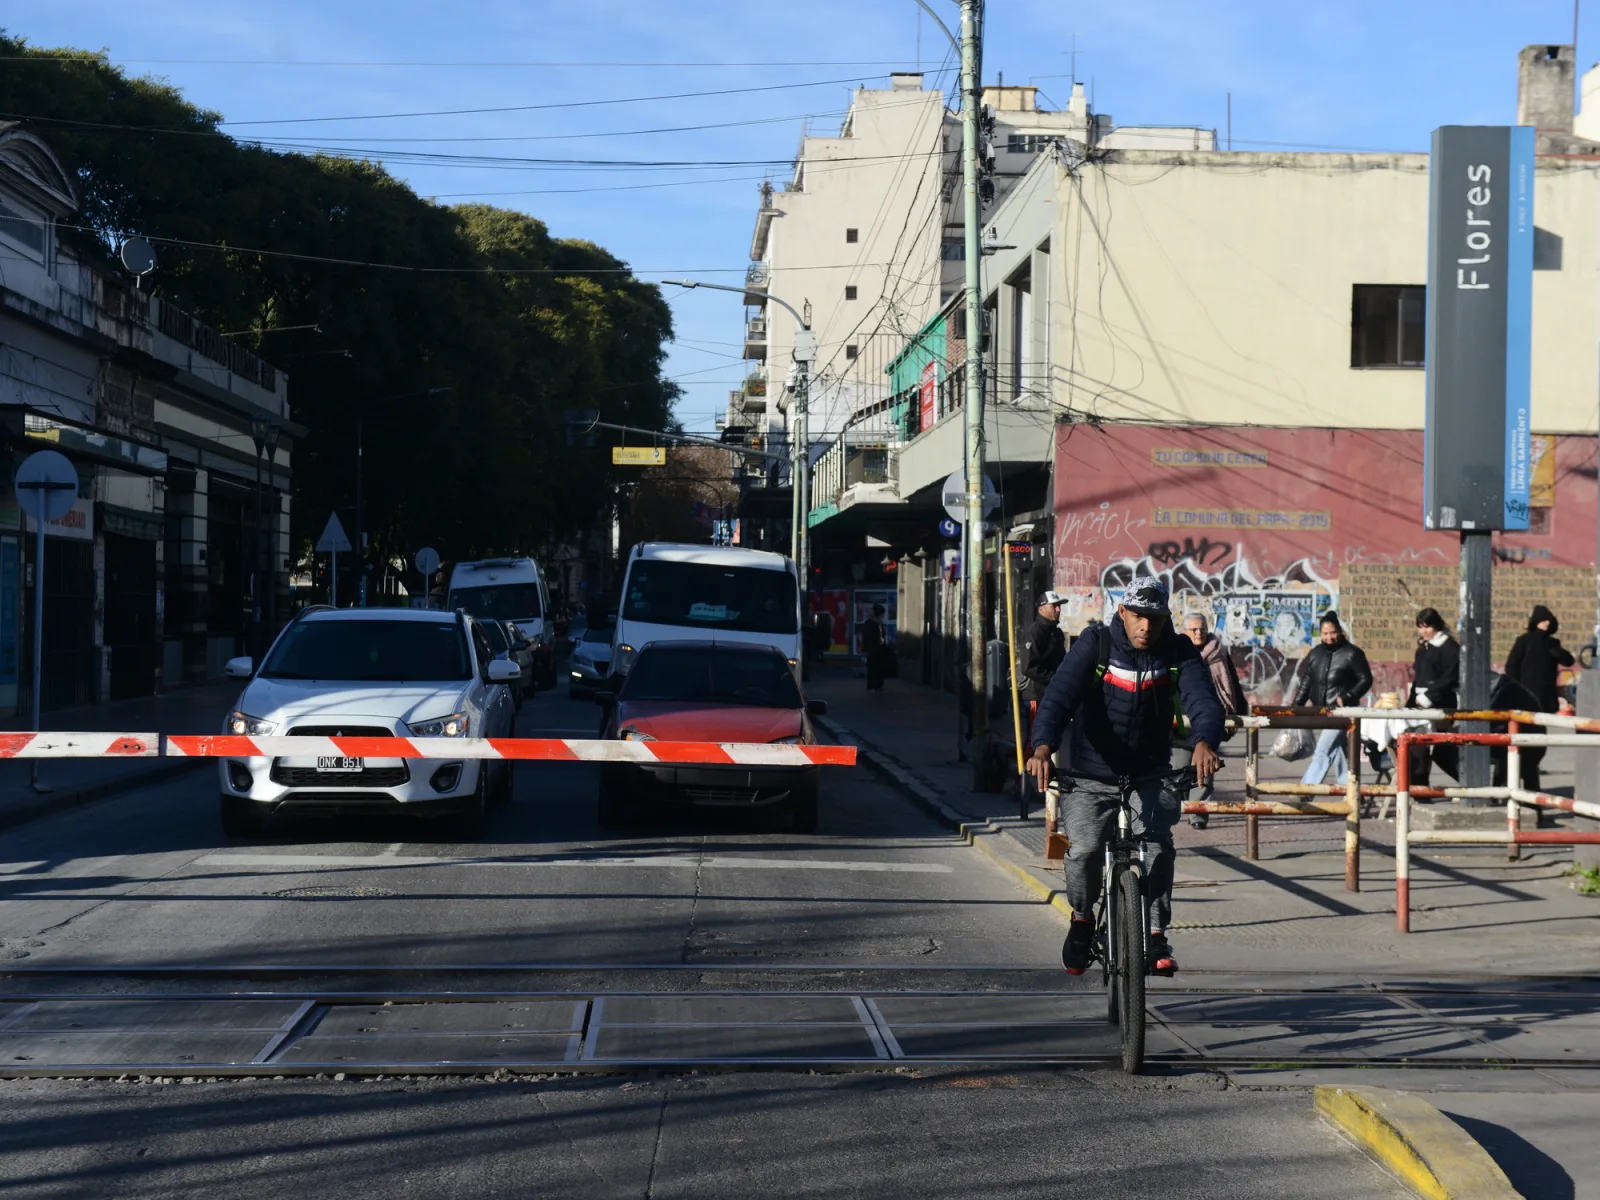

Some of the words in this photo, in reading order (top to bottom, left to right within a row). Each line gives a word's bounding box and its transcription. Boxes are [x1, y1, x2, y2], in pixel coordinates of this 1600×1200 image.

[1457, 164, 1491, 289] Flores
[1517, 408, 1526, 461] SARMIENTO
[1155, 451, 1172, 462] TU
[1174, 451, 1225, 463] COMUNA
[1155, 511, 1171, 524] LA
[1176, 511, 1228, 525] COMUNA
[1230, 512, 1253, 526] DEL
[1257, 513, 1289, 526] PAPA
[1299, 514, 1328, 527] 2015
[1002, 545, 1031, 553] OSCO
[319, 757, 337, 768] ONK
[342, 757, 361, 768] 851
